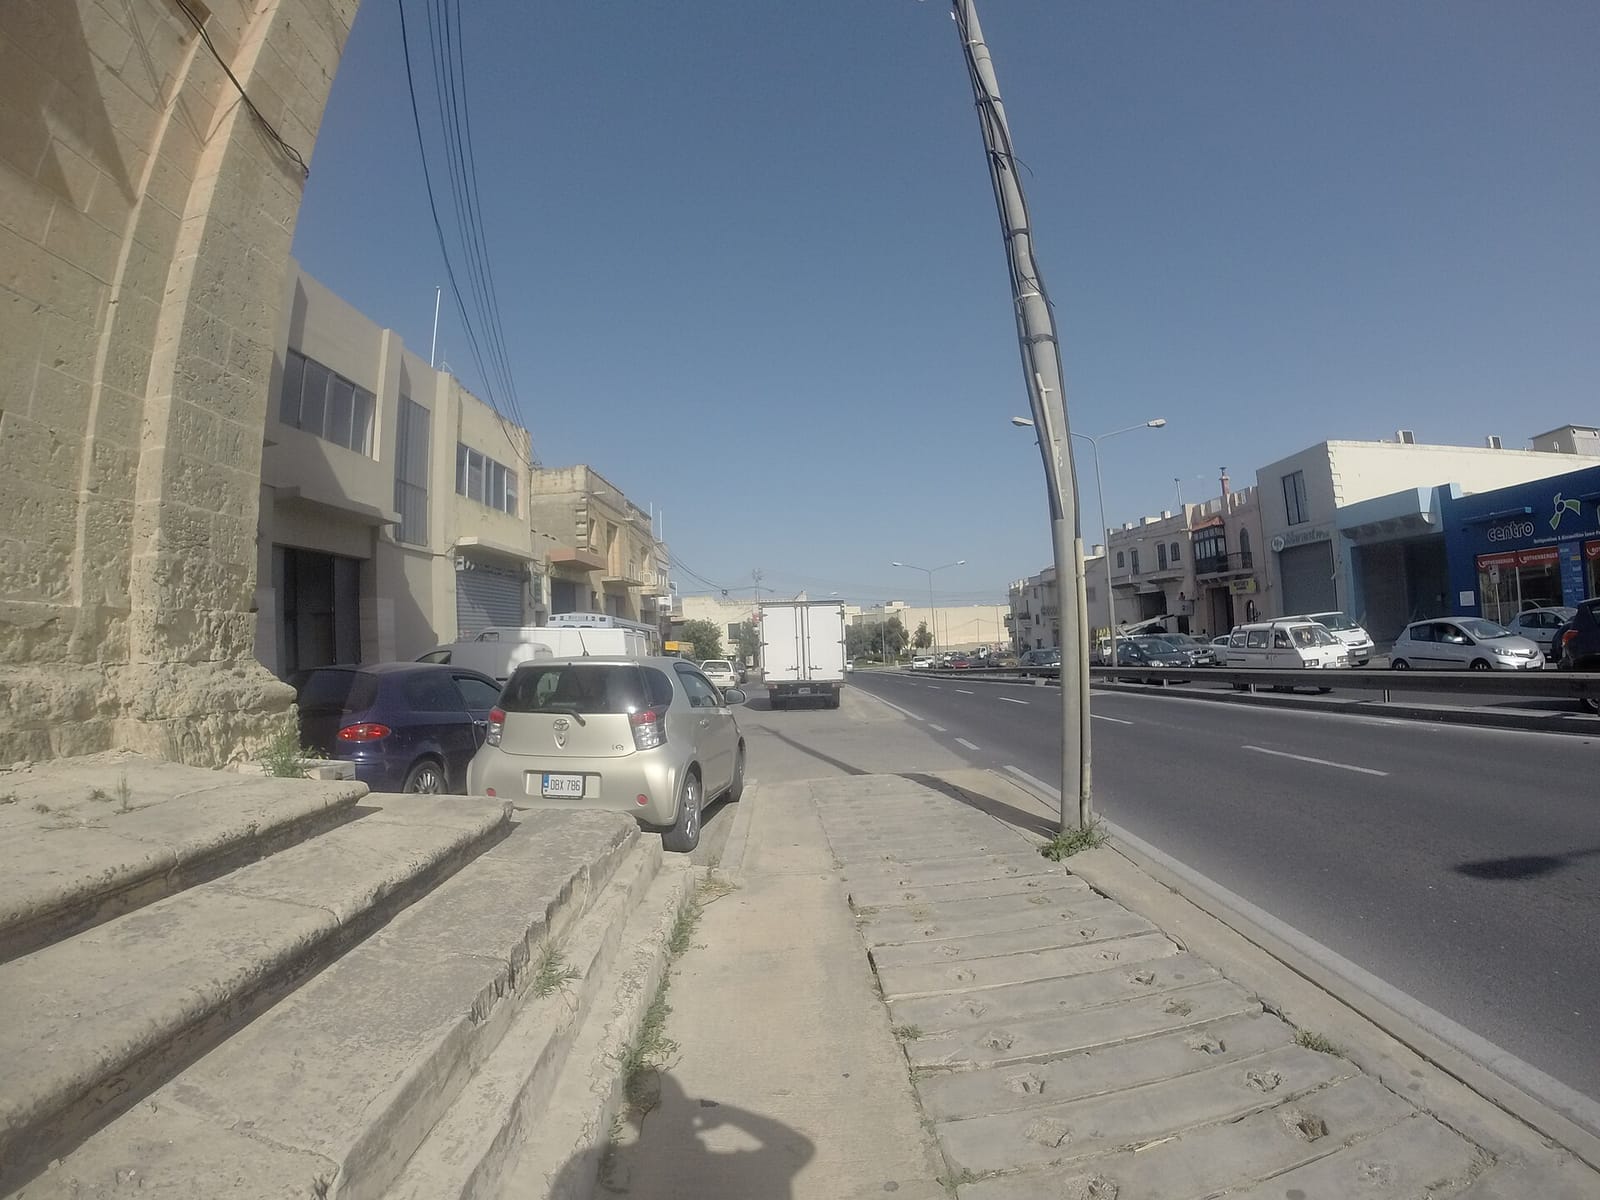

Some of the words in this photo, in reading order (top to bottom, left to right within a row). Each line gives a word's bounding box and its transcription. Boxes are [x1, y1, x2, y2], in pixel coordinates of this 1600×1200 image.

[1488, 521, 1534, 542] centro
[551, 779, 564, 791] DBX
[567, 779, 581, 791] 786
